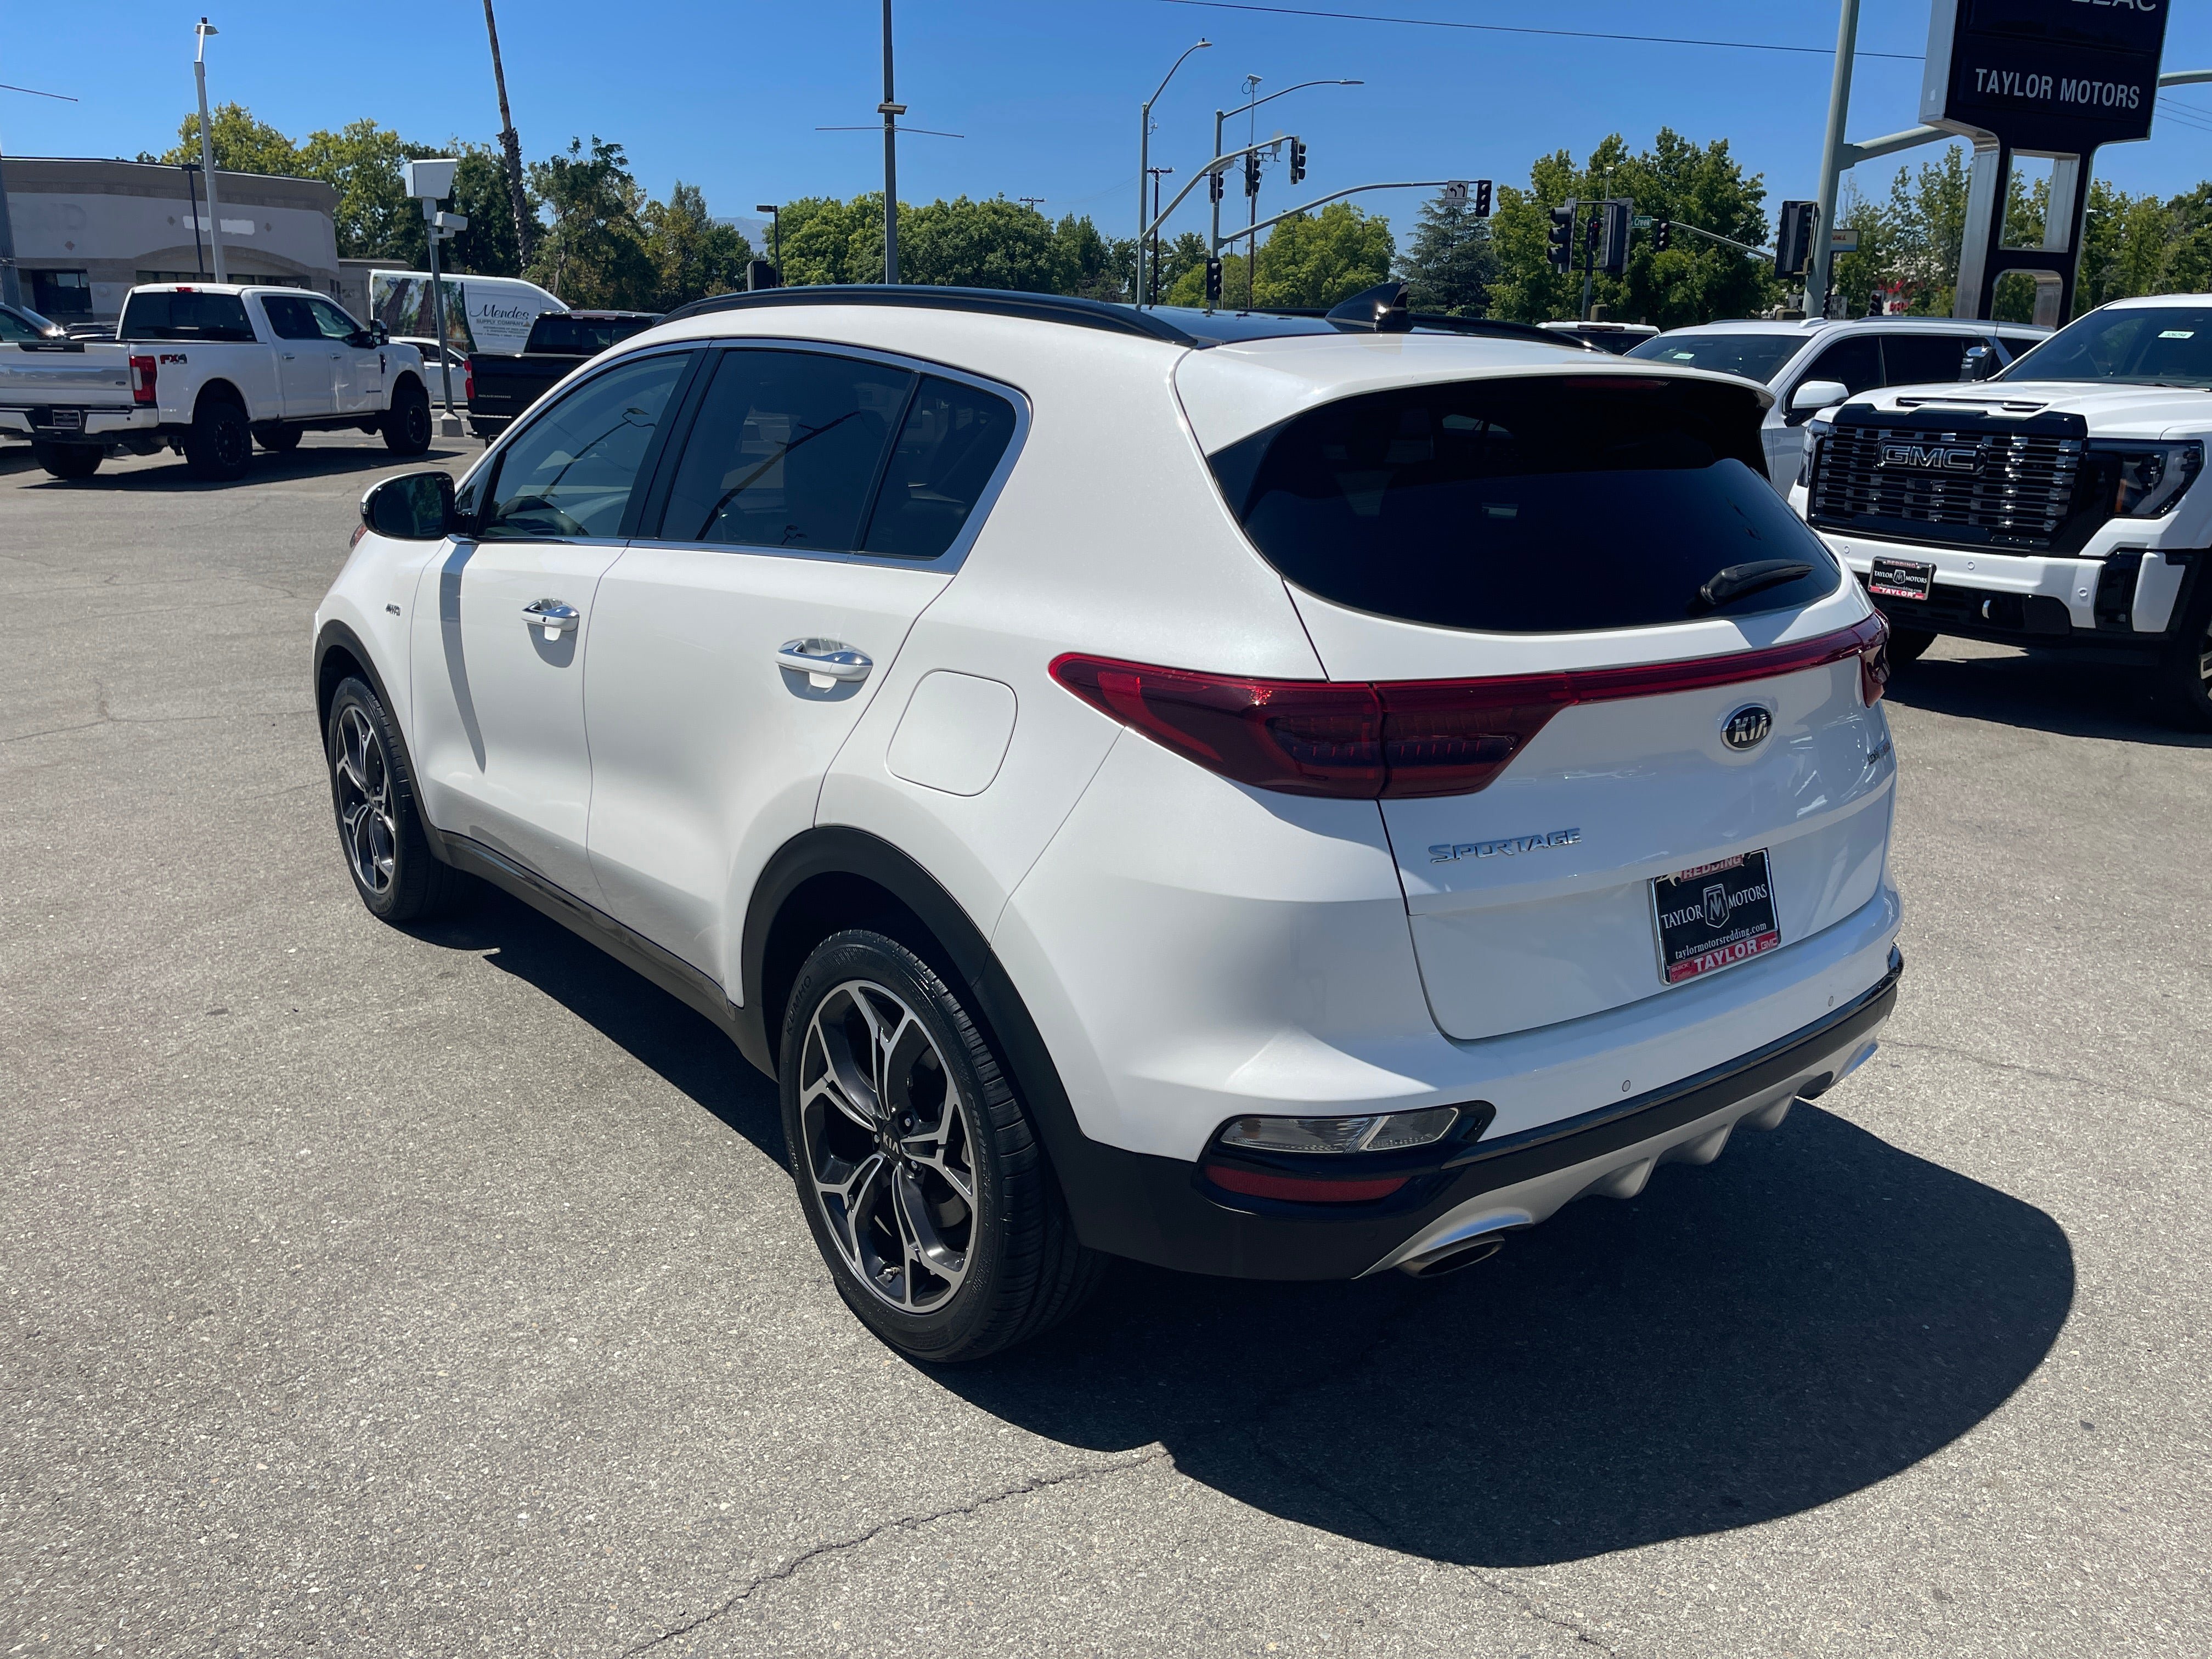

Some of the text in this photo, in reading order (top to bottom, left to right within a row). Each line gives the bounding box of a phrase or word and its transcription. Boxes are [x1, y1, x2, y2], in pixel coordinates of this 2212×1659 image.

[1976, 69, 2140, 109] TAYLOR MOTORS
[1634, 217, 1650, 226] Creek
[470, 304, 529, 320] Mendes
[160, 354, 188, 364] FX4
[1882, 445, 1976, 470] GMC
[1882, 588, 1914, 597] TAYLOR
[1733, 713, 1768, 743] KIA
[1428, 827, 1582, 864] SPORTAGE
[1684, 855, 1743, 879] REDDING
[1661, 904, 1704, 929] TAYLOR
[1728, 884, 1768, 909] MOTORS
[1675, 923, 1767, 960] taylormotorsredding.com
[1694, 939, 1758, 973] TAYLOR
[1760, 937, 1778, 950] GMC
[786, 975, 811, 1036] KUMHO
[883, 1131, 900, 1155] KIA
